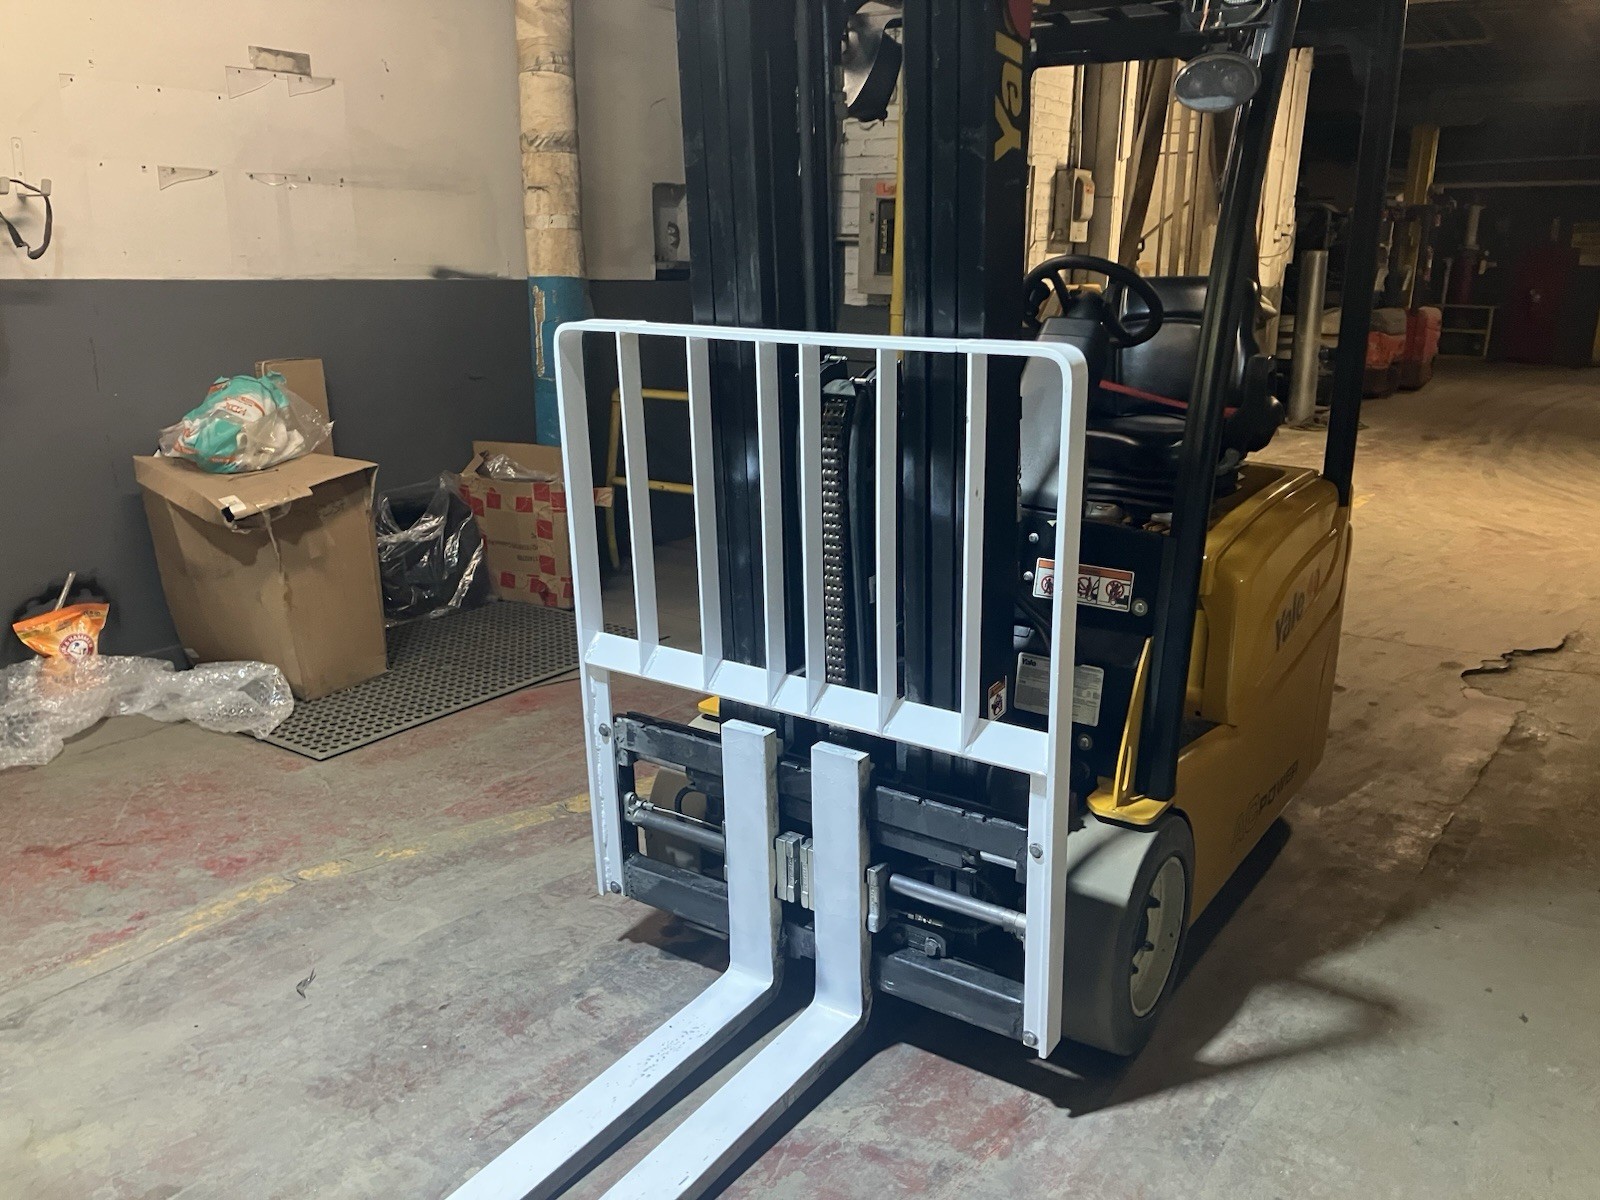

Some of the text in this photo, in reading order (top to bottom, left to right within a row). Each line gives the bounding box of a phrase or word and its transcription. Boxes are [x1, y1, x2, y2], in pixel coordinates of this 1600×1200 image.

[1275, 592, 1305, 651] Yale
[1021, 657, 1037, 667] Yale
[1258, 758, 1299, 815] POWER
